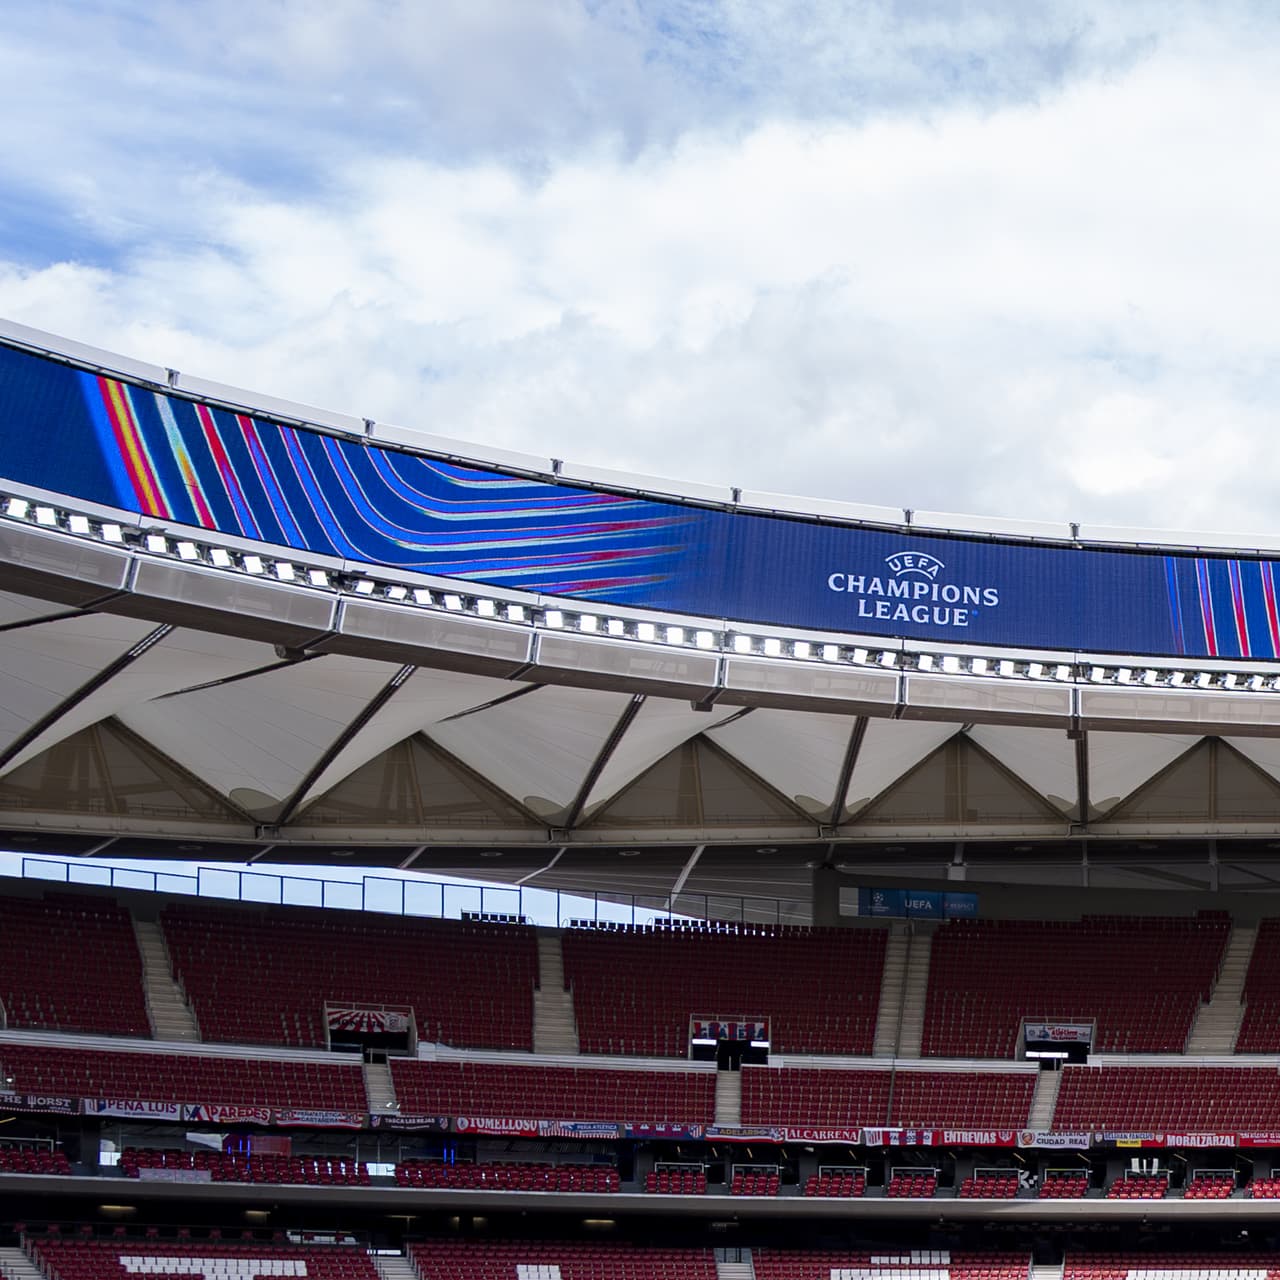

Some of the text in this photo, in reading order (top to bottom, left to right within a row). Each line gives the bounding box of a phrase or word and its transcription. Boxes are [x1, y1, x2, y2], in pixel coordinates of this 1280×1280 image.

[889, 555, 939, 578] UEFA
[828, 573, 999, 606] CHAMPIONS
[858, 600, 969, 626] LEAGUE
[904, 899, 932, 910] UEFA
[149, 1101, 177, 1114] LUIS
[209, 1105, 269, 1120] PAREDES
[1036, 1138, 1088, 1147] CIUDAD REAL
